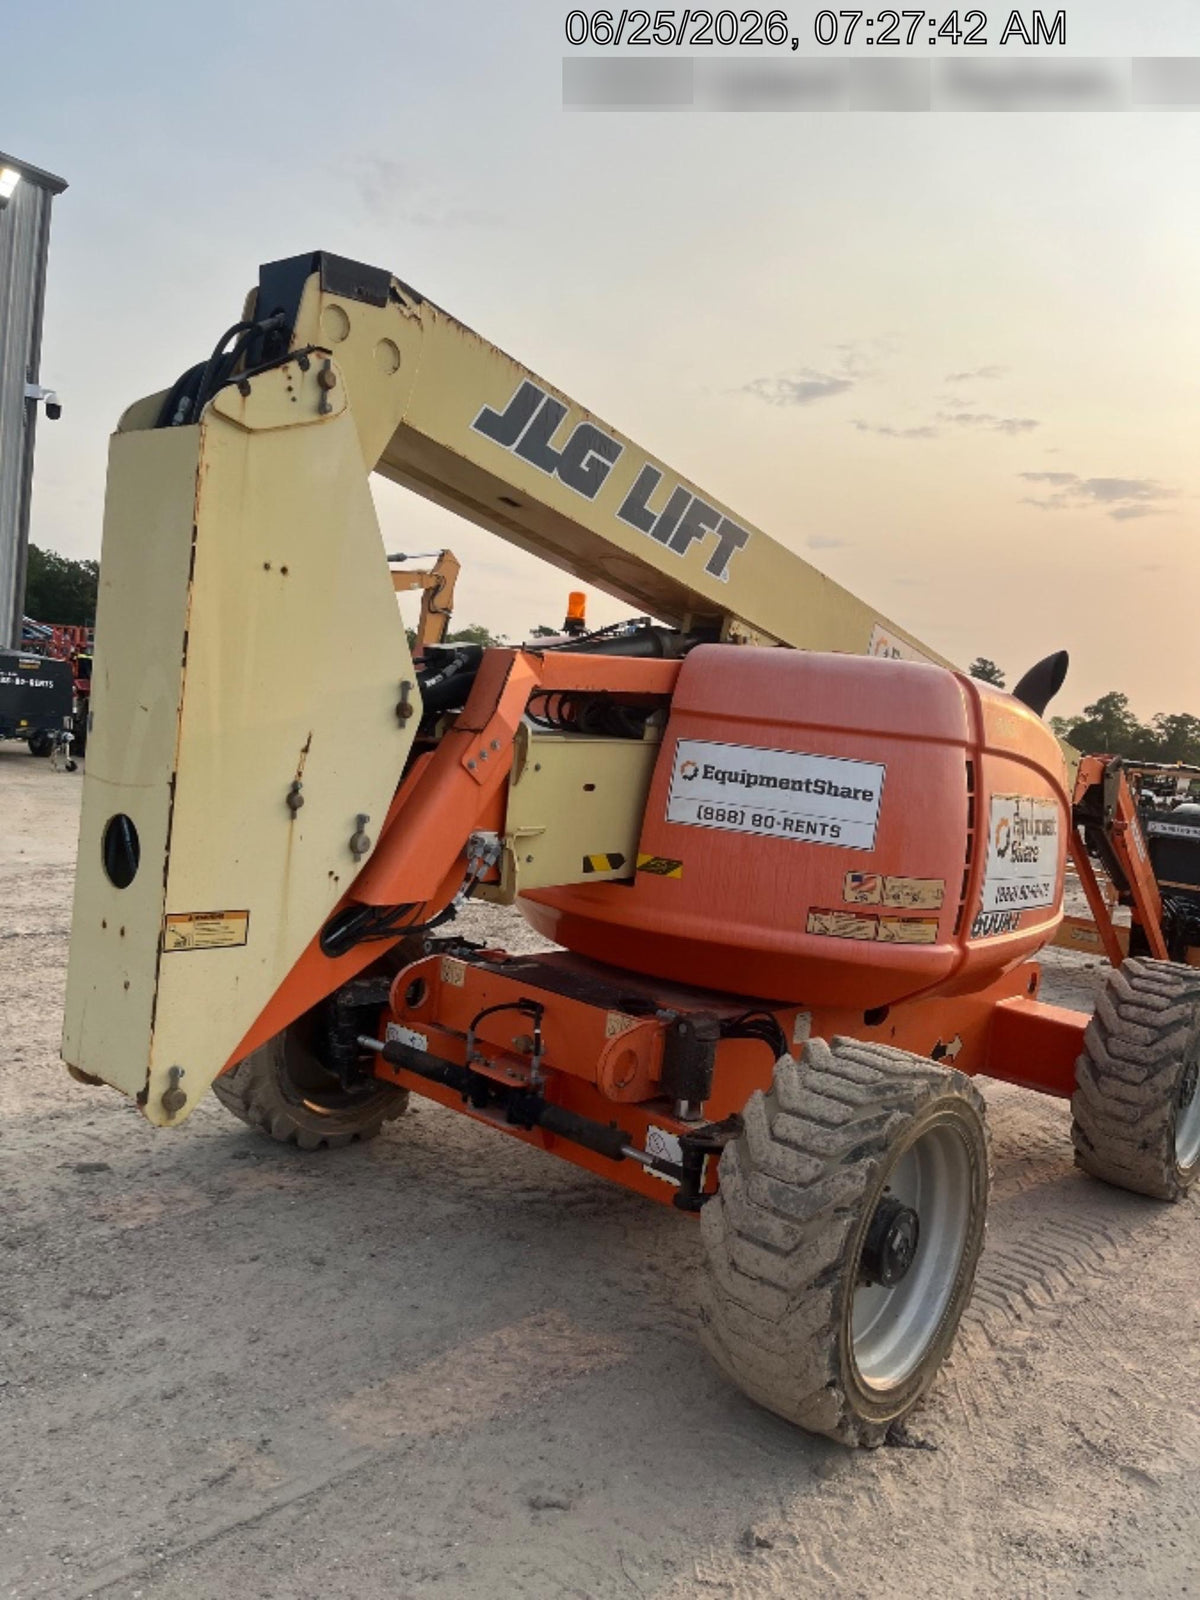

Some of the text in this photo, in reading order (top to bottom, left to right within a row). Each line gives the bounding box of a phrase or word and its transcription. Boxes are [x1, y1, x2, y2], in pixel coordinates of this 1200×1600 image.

[470, 378, 751, 580] JLG LIFT
[702, 764, 874, 802] EquipmentShare
[696, 805, 842, 839] (888) 80-RENTS
